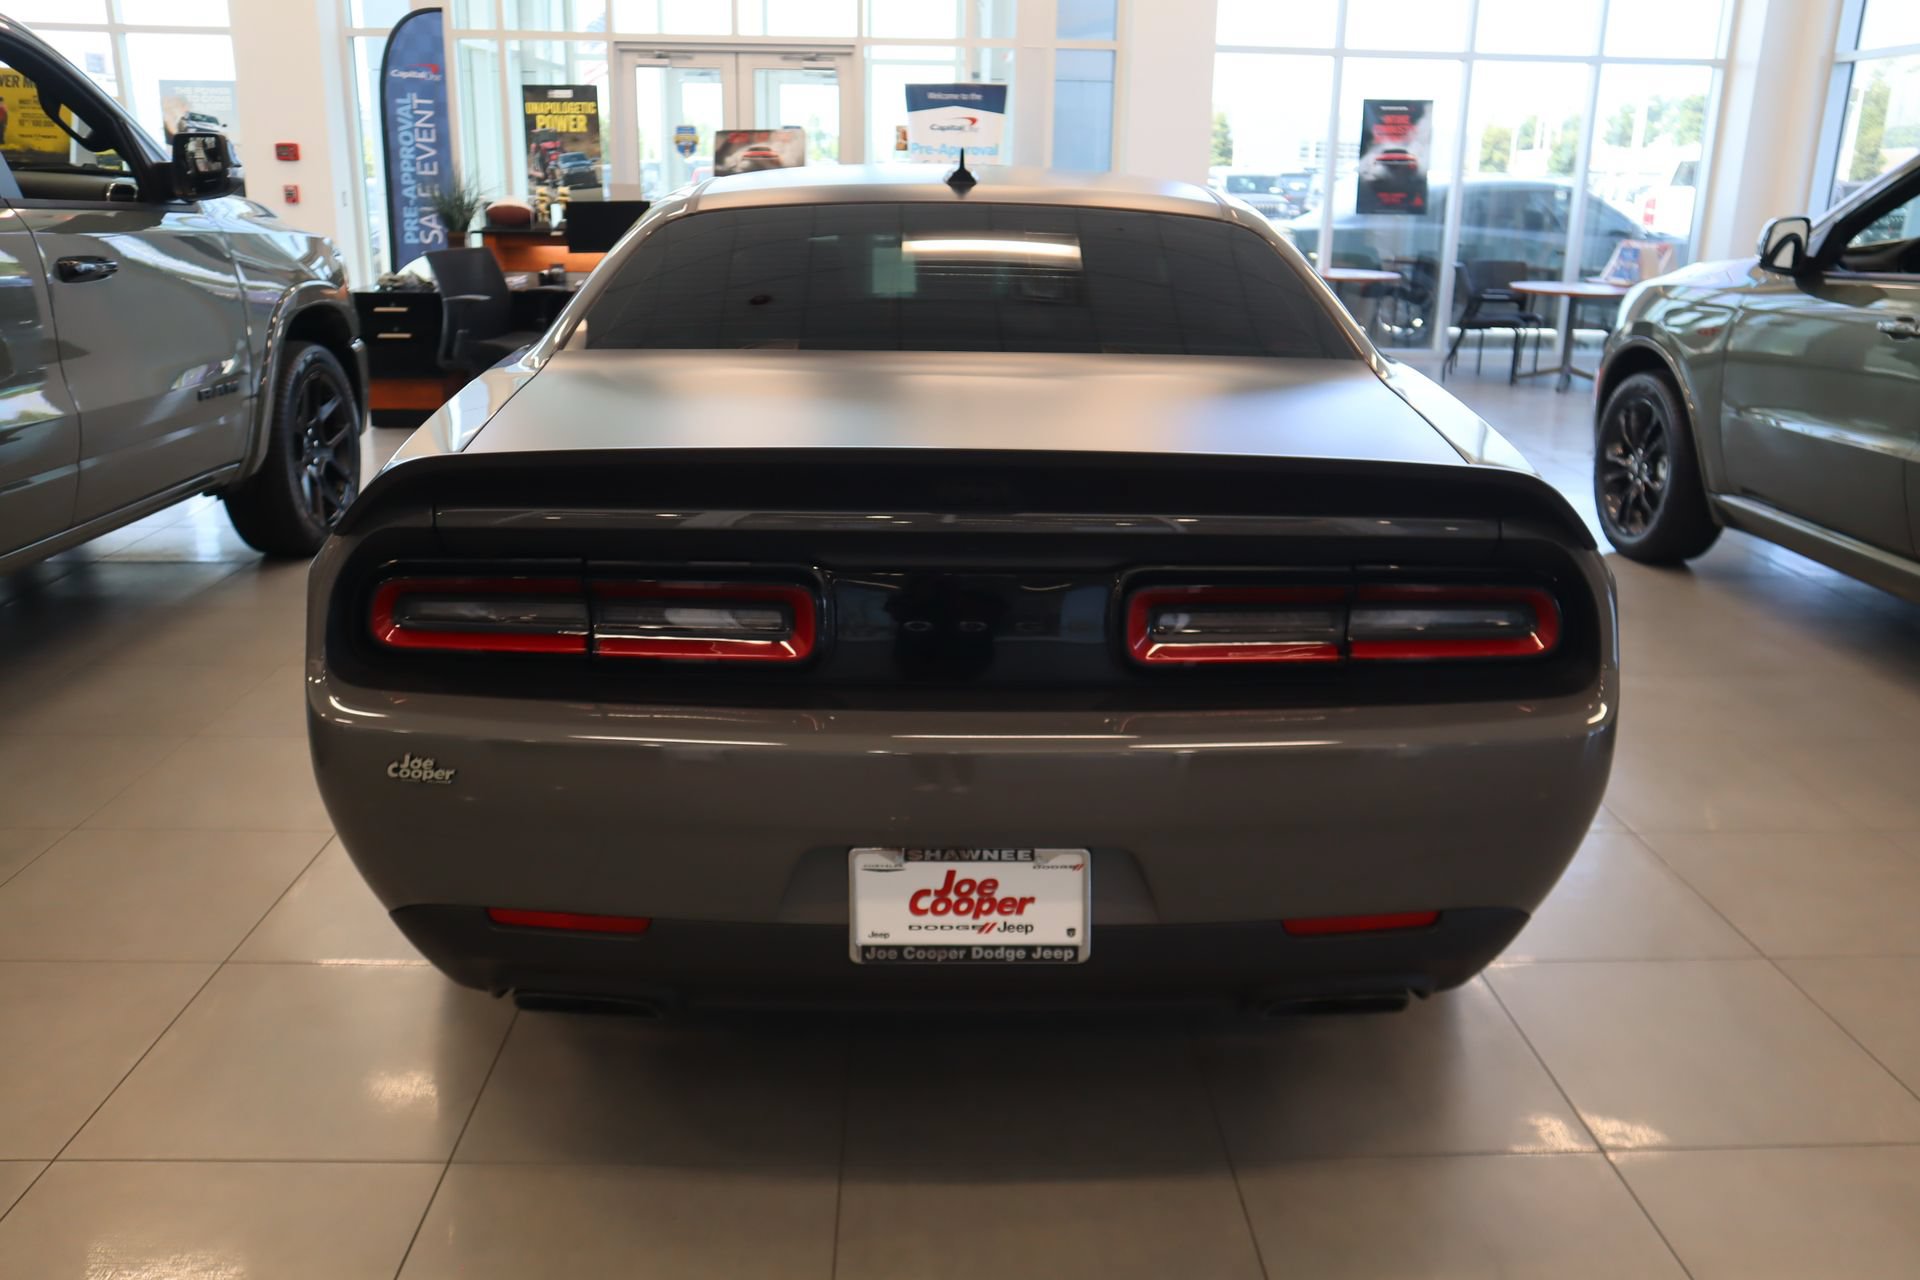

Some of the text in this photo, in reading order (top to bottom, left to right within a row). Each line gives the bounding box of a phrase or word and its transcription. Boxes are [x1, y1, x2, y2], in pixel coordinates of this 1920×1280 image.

[927, 92, 959, 100] Welcome
[525, 102, 597, 114] UNAPOLOGETIC
[536, 115, 587, 132] POWER
[412, 92, 439, 176] EVENT
[396, 92, 420, 244] PRE-APPROVAL
[400, 752, 434, 769] Joe
[387, 761, 455, 781] Cooper
[907, 849, 1032, 861] SHAWNEE
[934, 869, 999, 898] Joe
[909, 889, 1035, 920] Cooper
[867, 931, 890, 939] Jeep
[997, 921, 1034, 935] Jeep
[865, 946, 1074, 962] Joe Cooper Dodge Jeep
